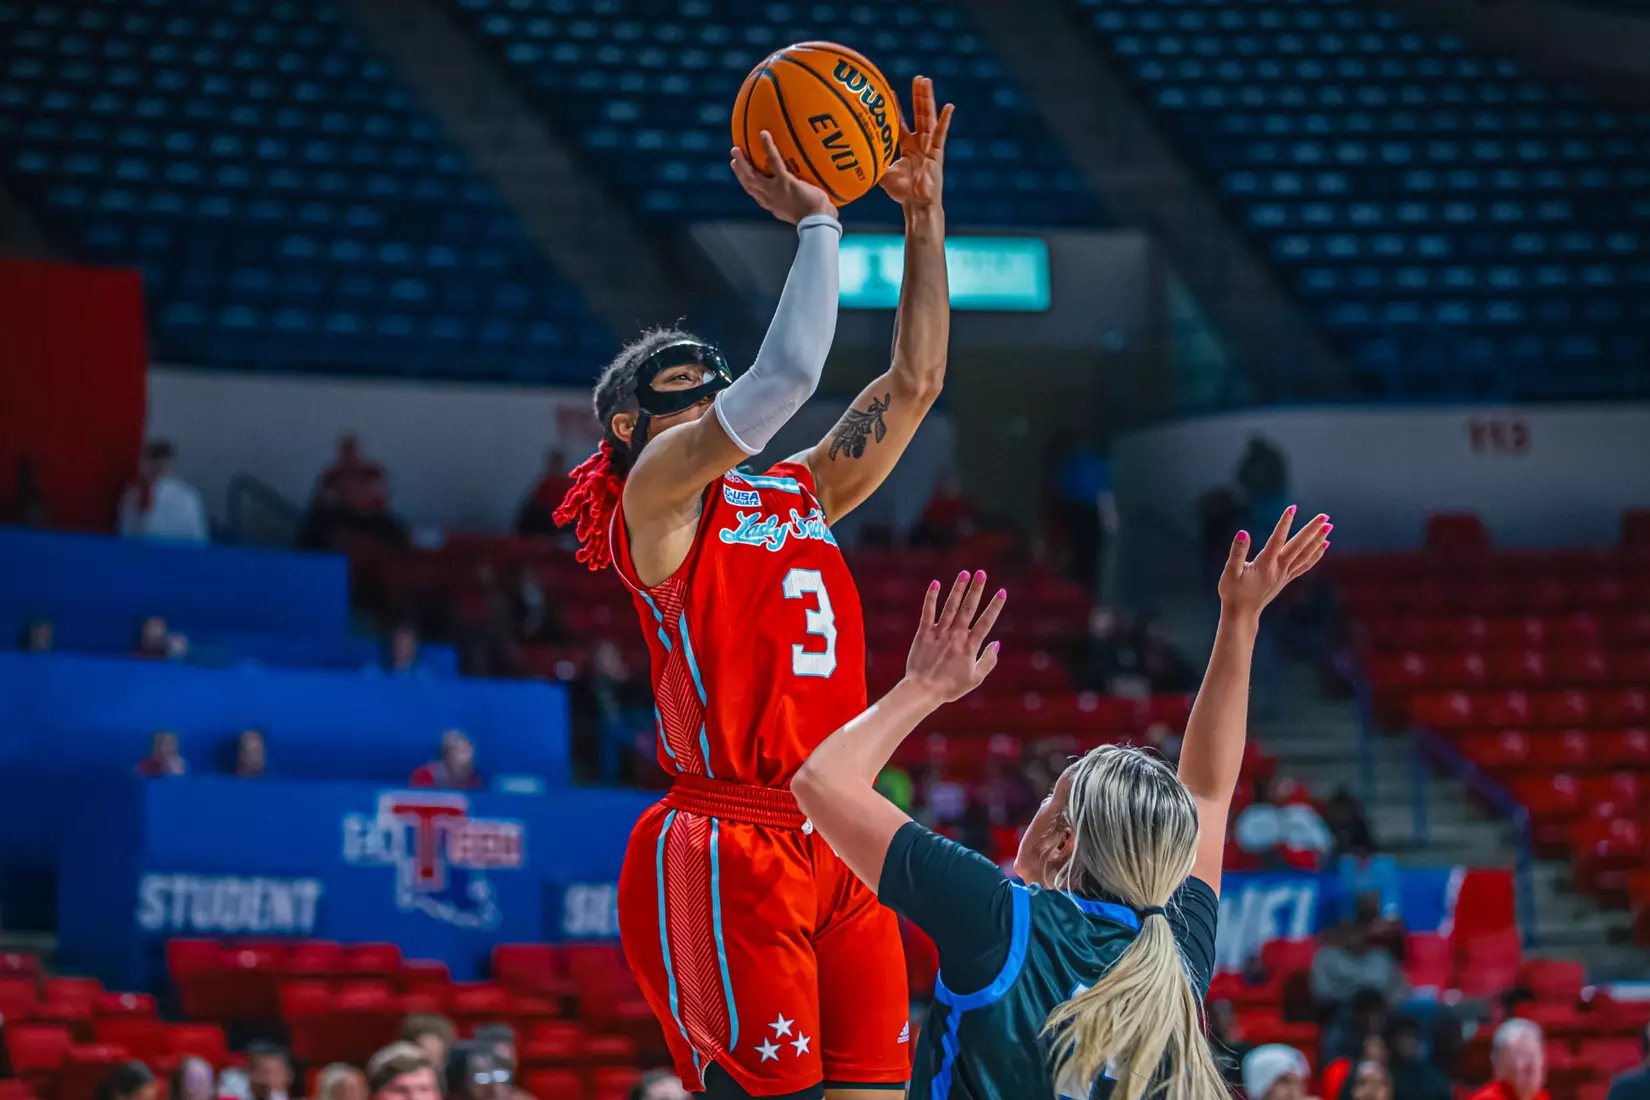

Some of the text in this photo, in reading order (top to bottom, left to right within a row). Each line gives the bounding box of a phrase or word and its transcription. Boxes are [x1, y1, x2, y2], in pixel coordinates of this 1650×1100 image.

[807, 113, 858, 171] EVO
[832, 58, 893, 168] Wilson
[719, 509, 789, 552] Lady
[782, 568, 837, 678] 3
[138, 873, 320, 933] STUDENT
